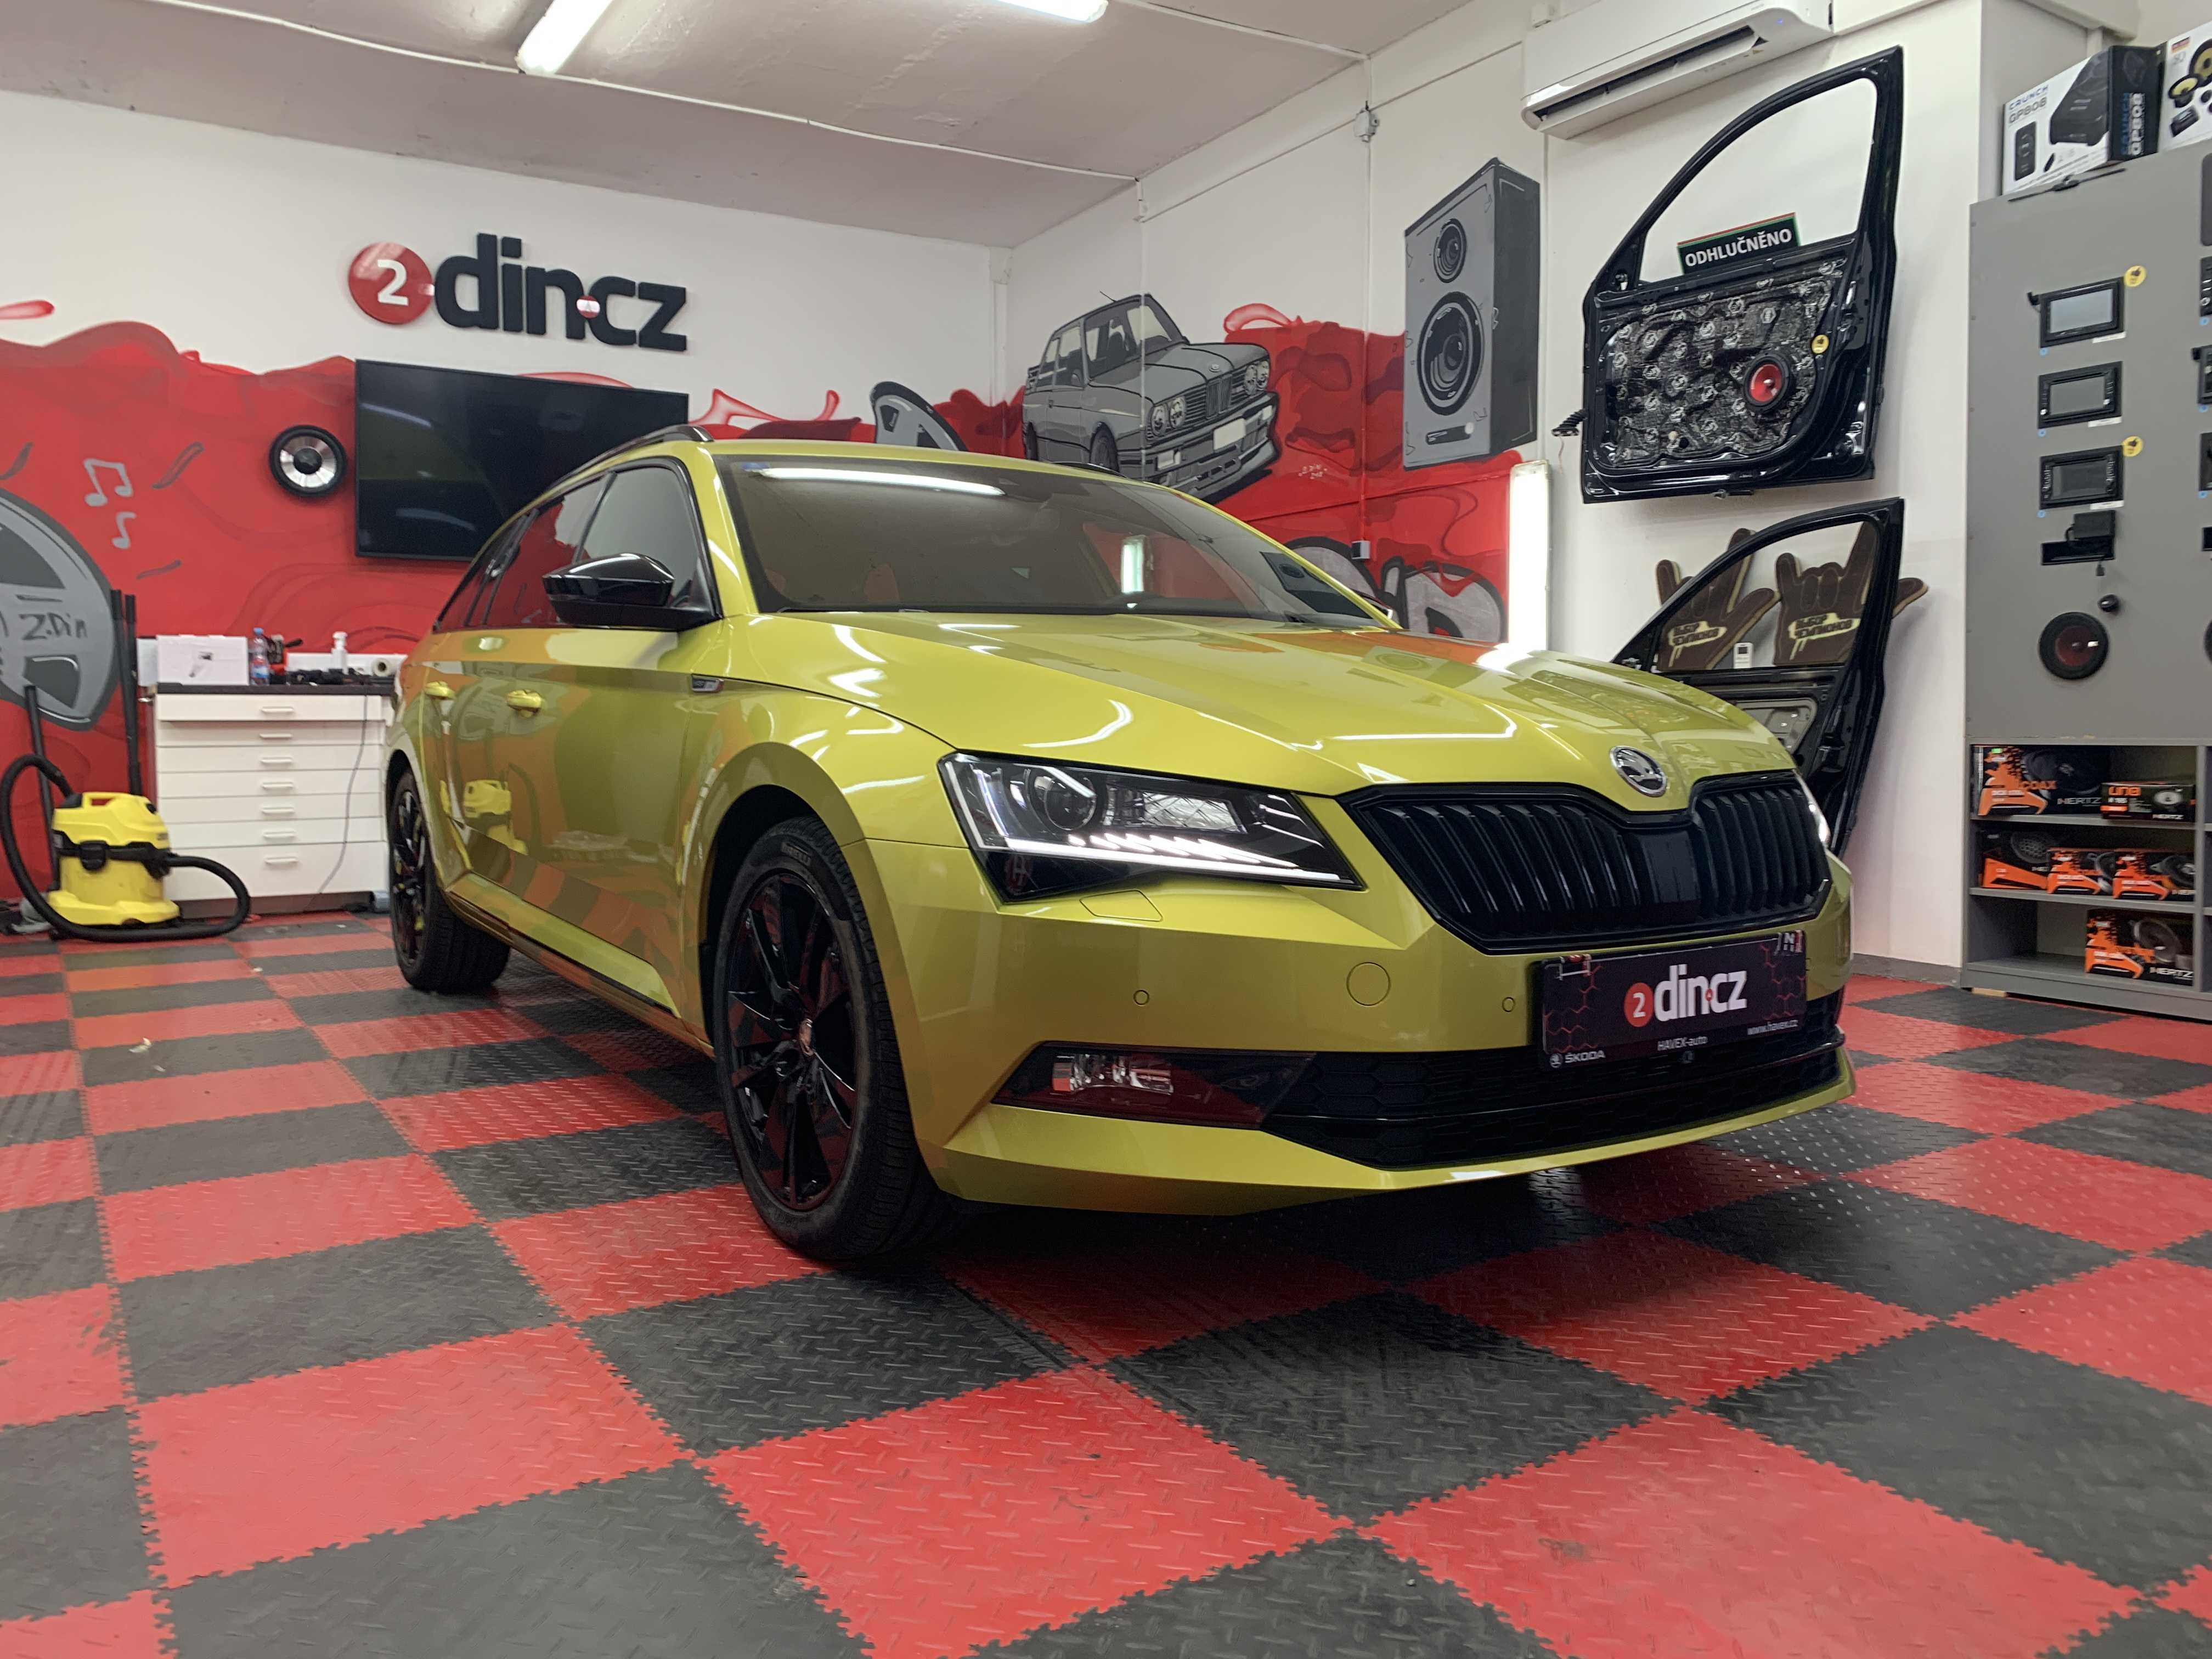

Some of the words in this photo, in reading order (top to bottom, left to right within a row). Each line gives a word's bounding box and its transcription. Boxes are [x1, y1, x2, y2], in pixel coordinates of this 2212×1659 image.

[1685, 228, 1792, 267] ODHLUČNĚNO
[2150, 966, 2194, 978] HERTZ
[1565, 1050, 1606, 1063] ŠKODA
